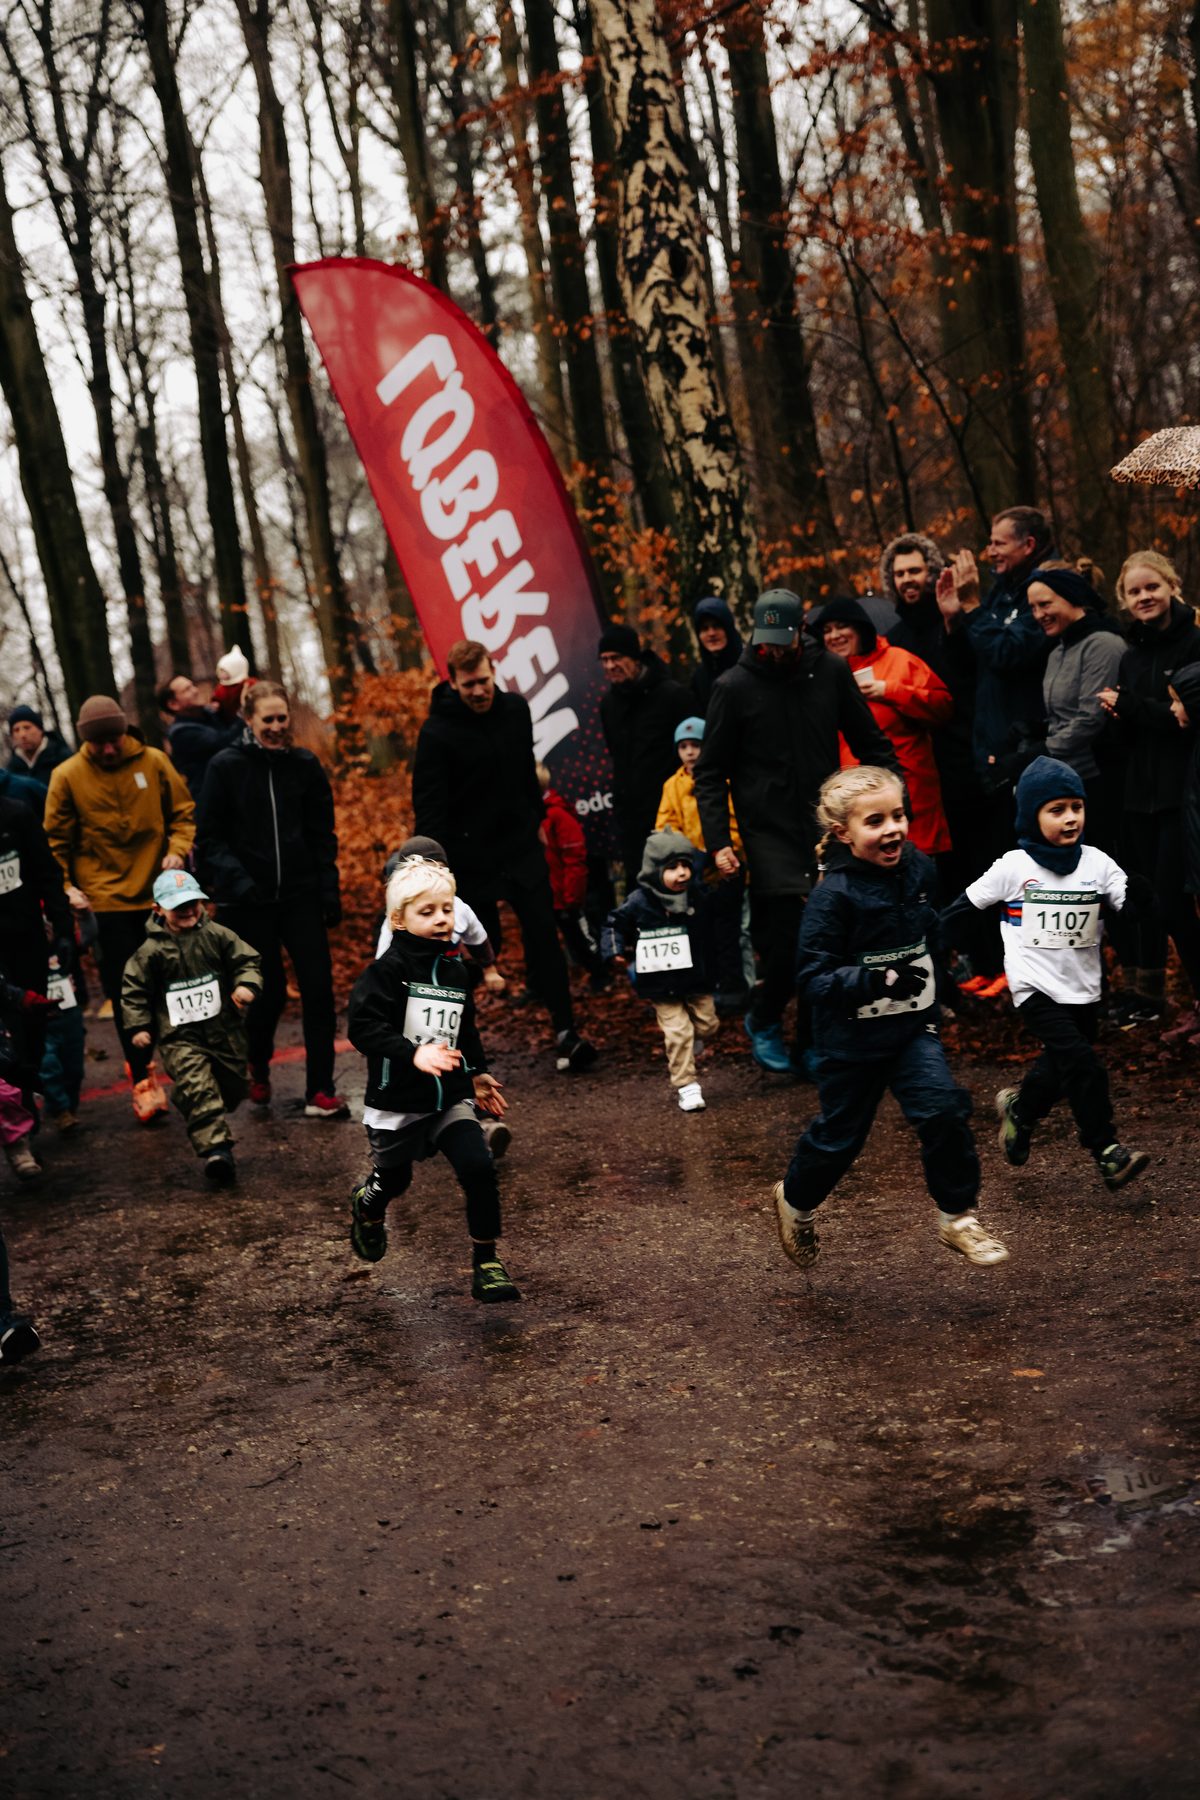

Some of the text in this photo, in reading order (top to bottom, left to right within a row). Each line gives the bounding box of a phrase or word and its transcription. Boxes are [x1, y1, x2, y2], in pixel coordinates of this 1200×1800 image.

[1030, 892, 1062, 901] CROSS
[1062, 893, 1081, 901] CUP
[1037, 911, 1090, 930] 1107
[642, 942, 680, 958] 1176
[176, 989, 213, 1009] 1179
[417, 986, 448, 998] CROSS
[422, 1006, 461, 1030] 110
